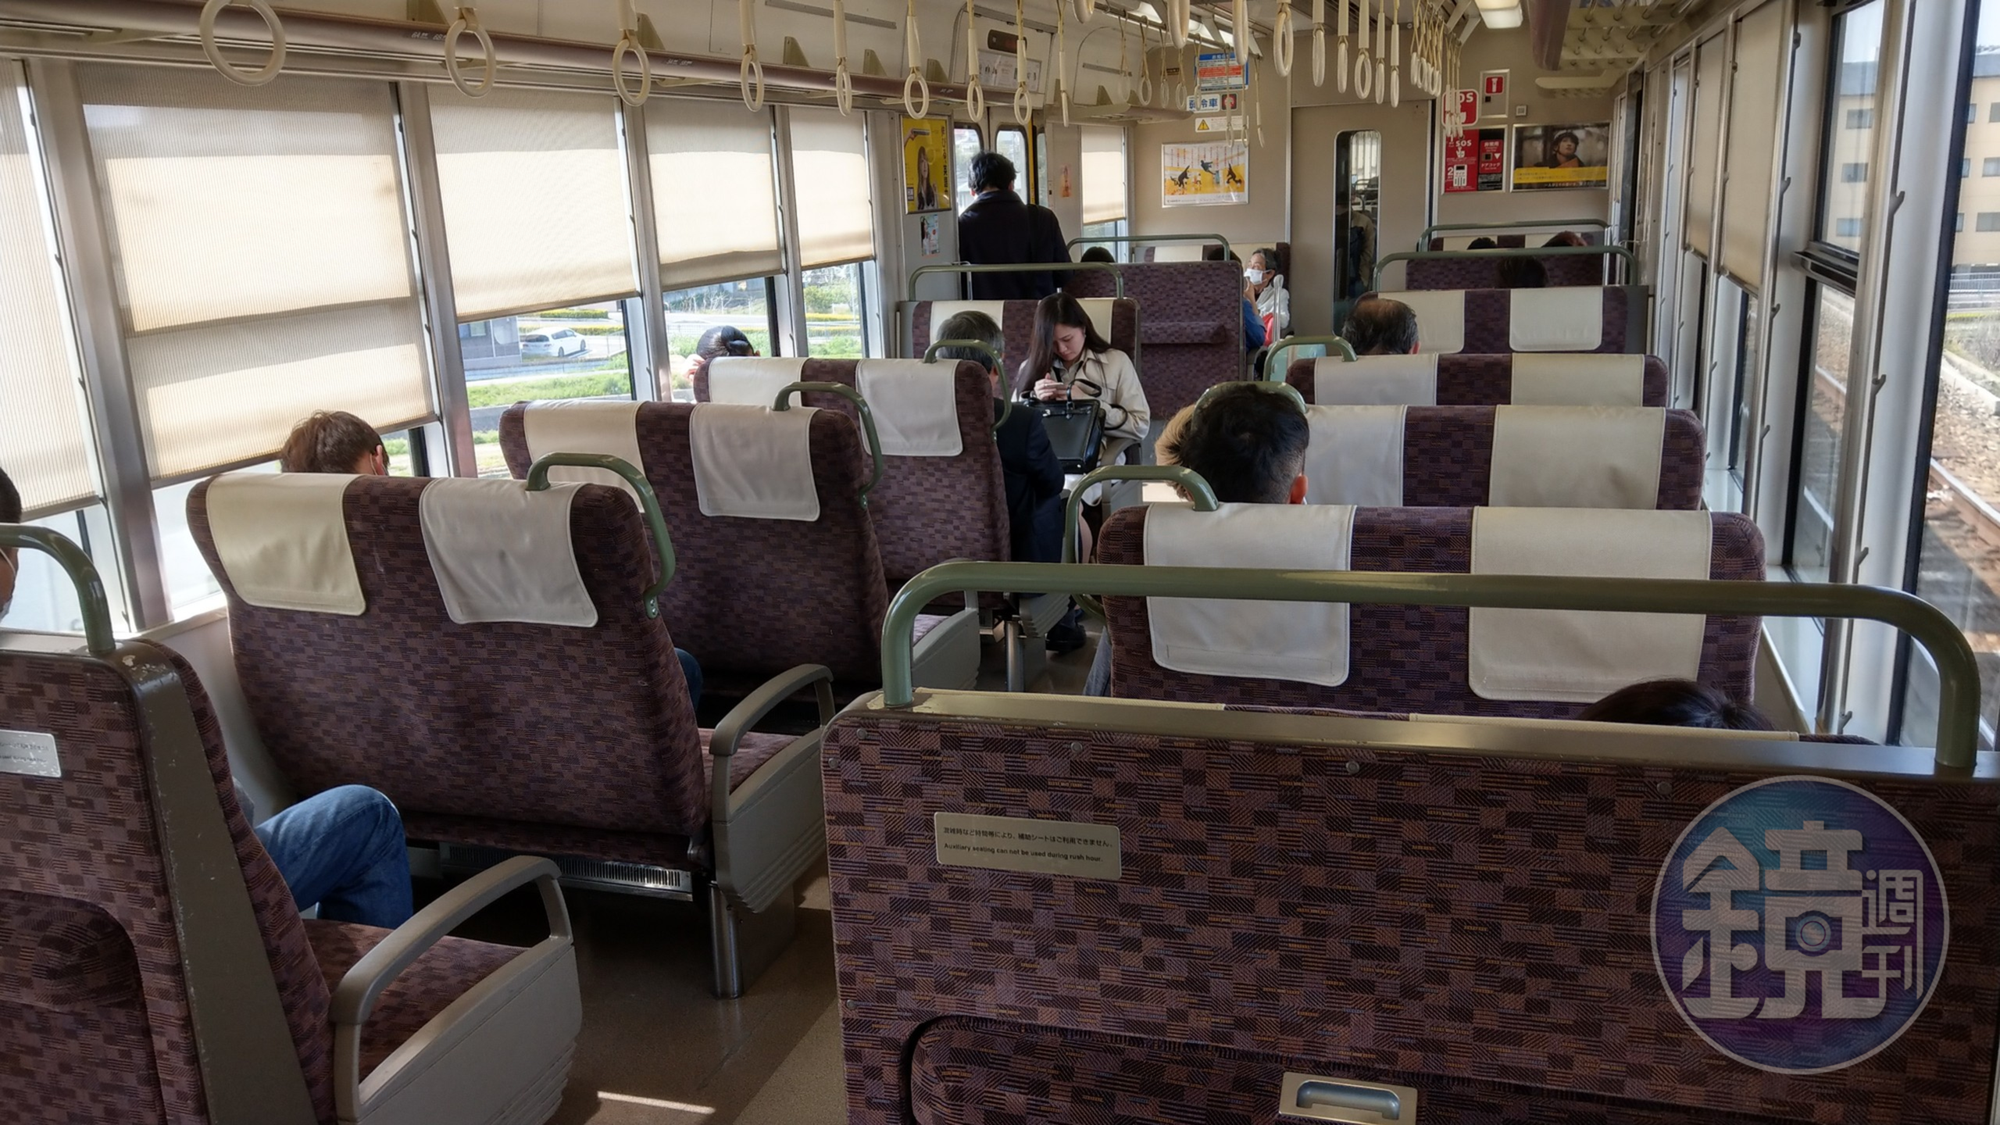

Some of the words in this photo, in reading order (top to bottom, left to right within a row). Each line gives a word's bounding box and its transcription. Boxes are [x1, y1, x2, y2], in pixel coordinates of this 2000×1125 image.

[1447, 166, 1454, 176] 2
[944, 843, 971, 852] Auxiliary
[972, 846, 995, 854] seating
[1047, 851, 1068, 860] during
